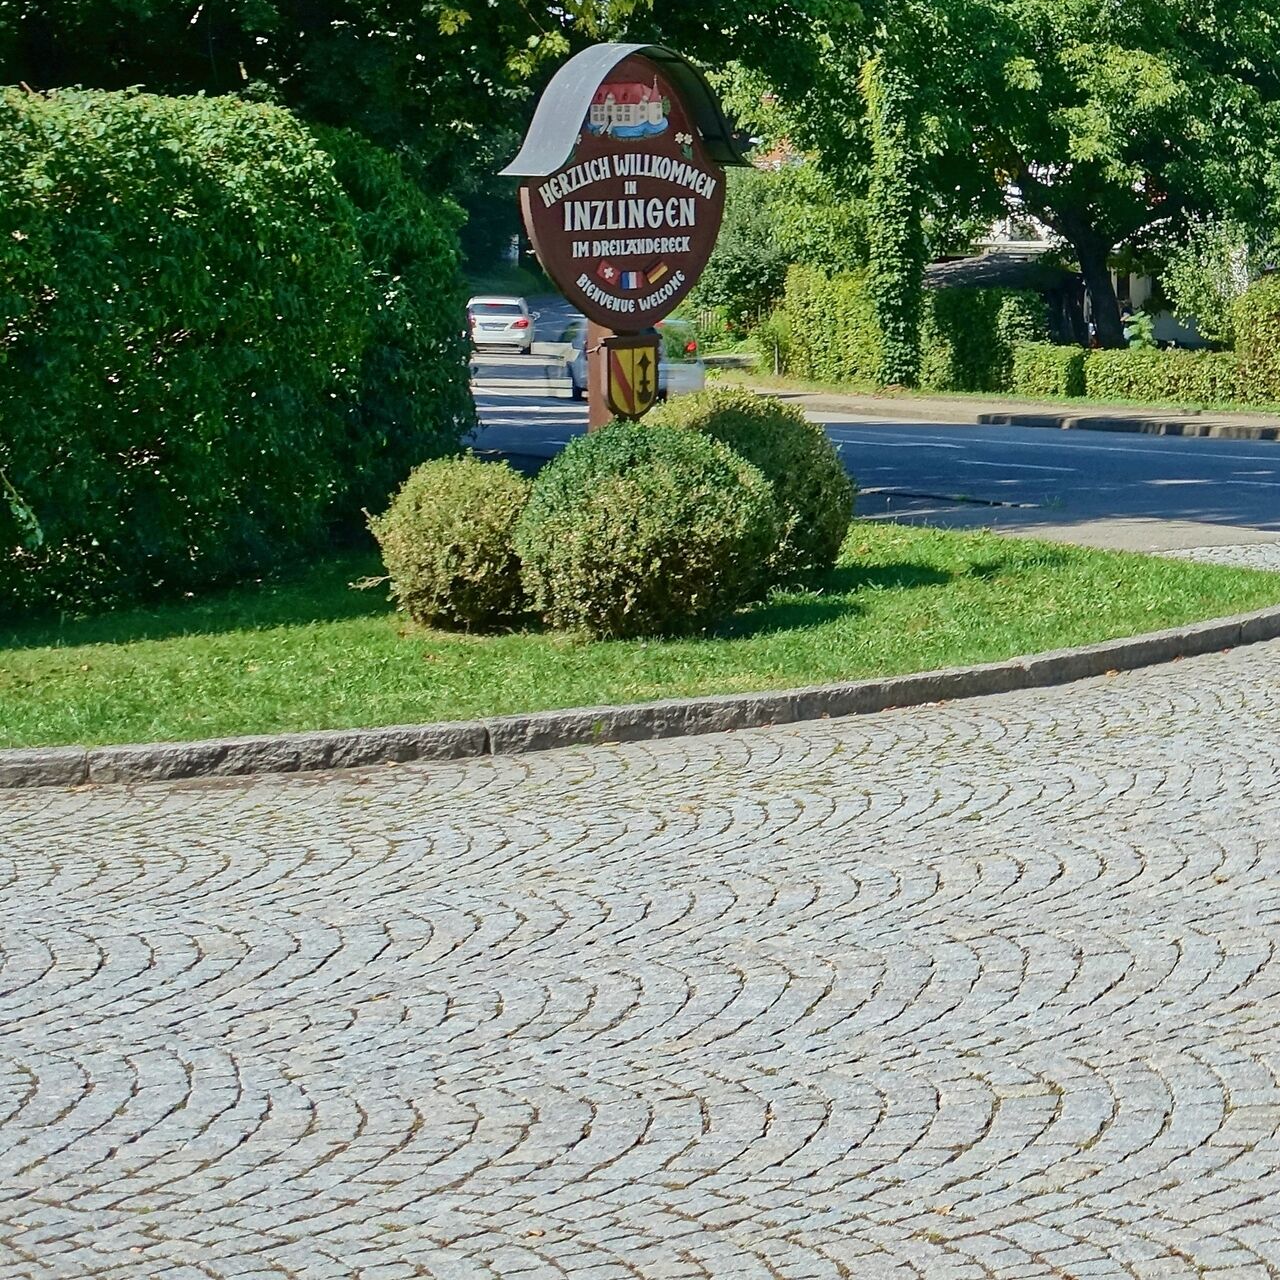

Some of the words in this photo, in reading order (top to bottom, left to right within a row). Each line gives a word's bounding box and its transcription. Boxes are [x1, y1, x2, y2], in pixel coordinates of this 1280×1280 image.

[538, 156, 611, 208] HERZLICH
[613, 154, 717, 200] WILLKOMMEN
[624, 181, 637, 195] IN
[564, 197, 696, 231] INZLINGEN
[572, 241, 590, 258] IM
[592, 236, 691, 257] DREILÄNDERECK
[576, 273, 636, 313] BIENVENUE
[638, 270, 686, 312] WELCOME
